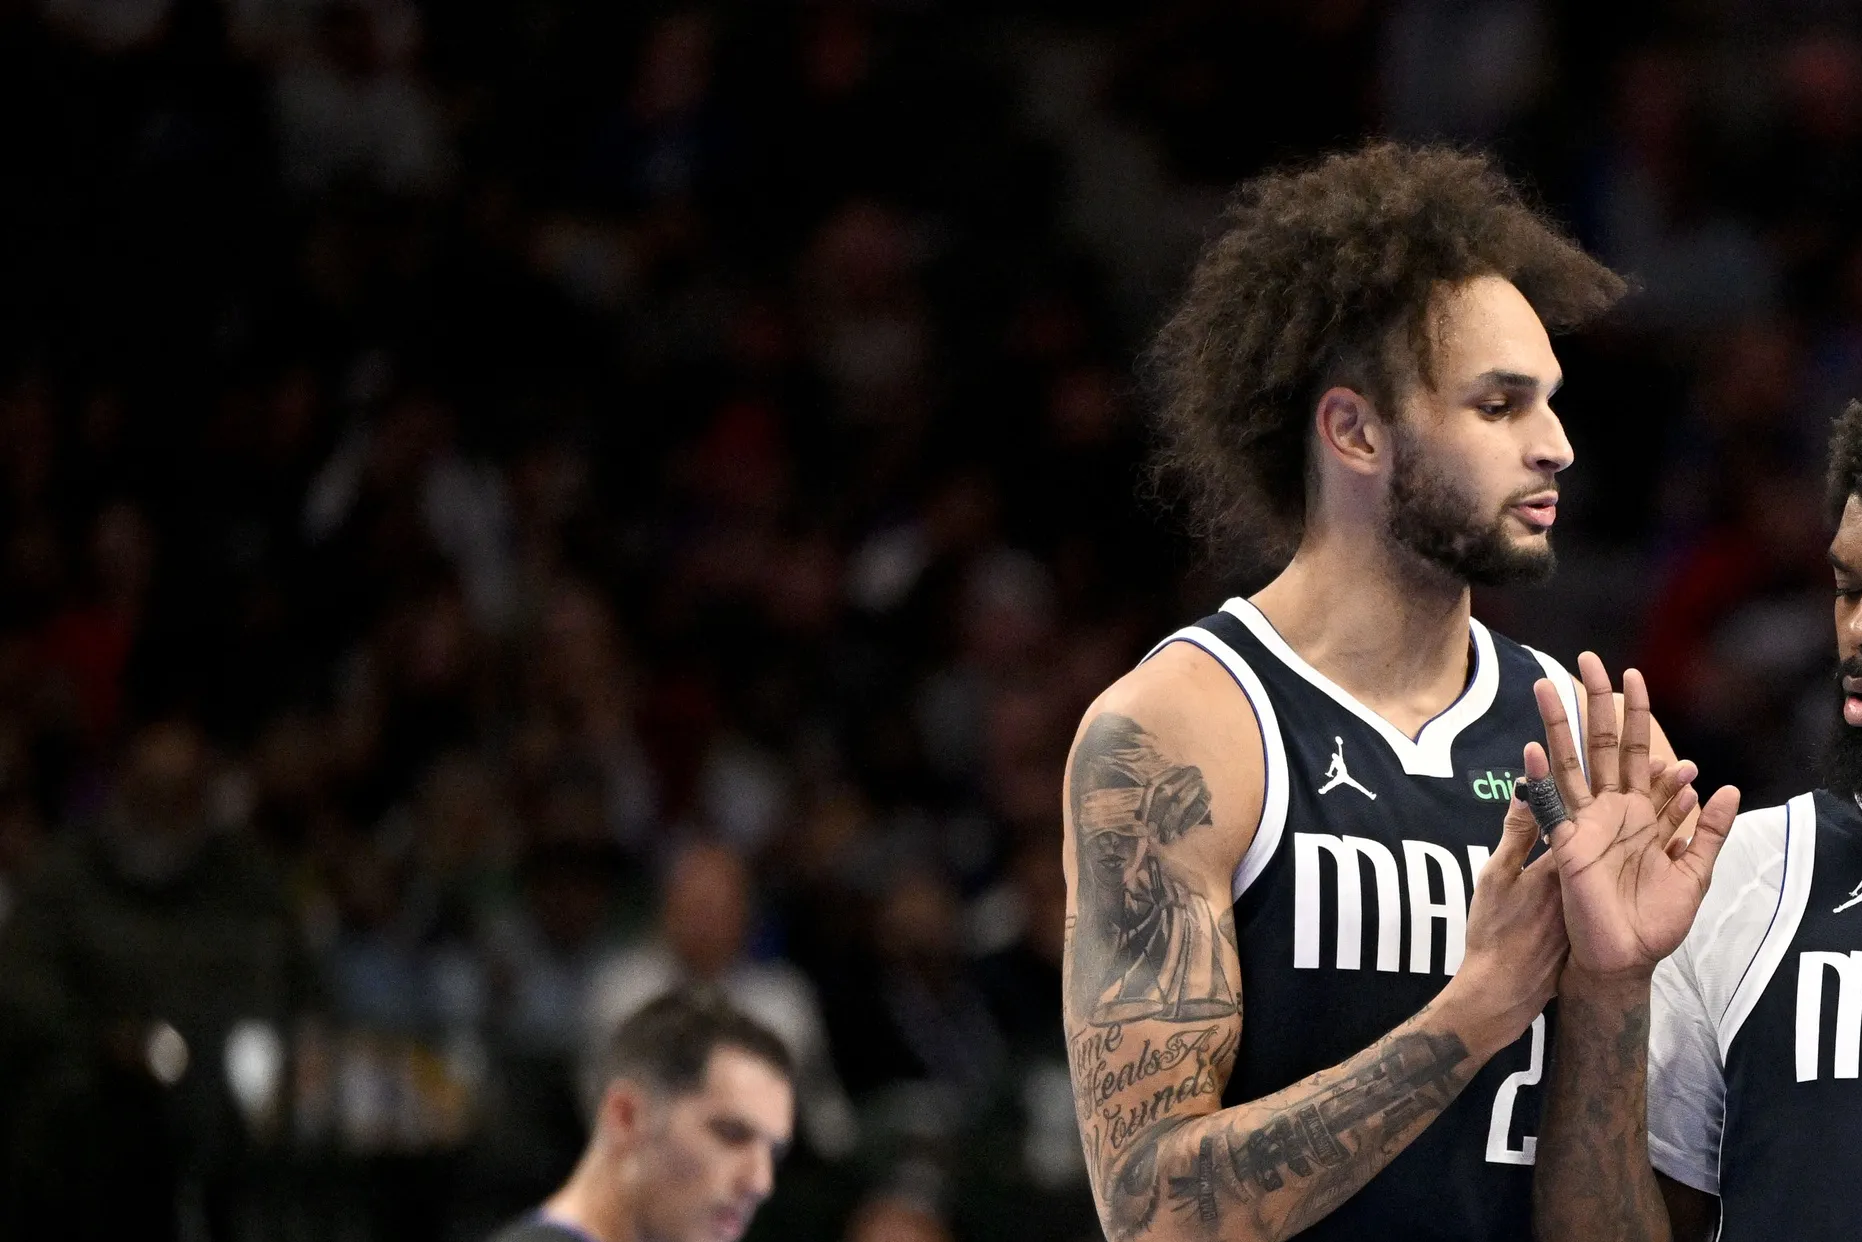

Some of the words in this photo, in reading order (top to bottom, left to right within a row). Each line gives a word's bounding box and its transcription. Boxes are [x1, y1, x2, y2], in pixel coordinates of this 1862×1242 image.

[1473, 771, 1511, 800] chi
[1294, 832, 1490, 976] MA
[1080, 1039, 1163, 1120] Heals
[1160, 1024, 1239, 1069] All
